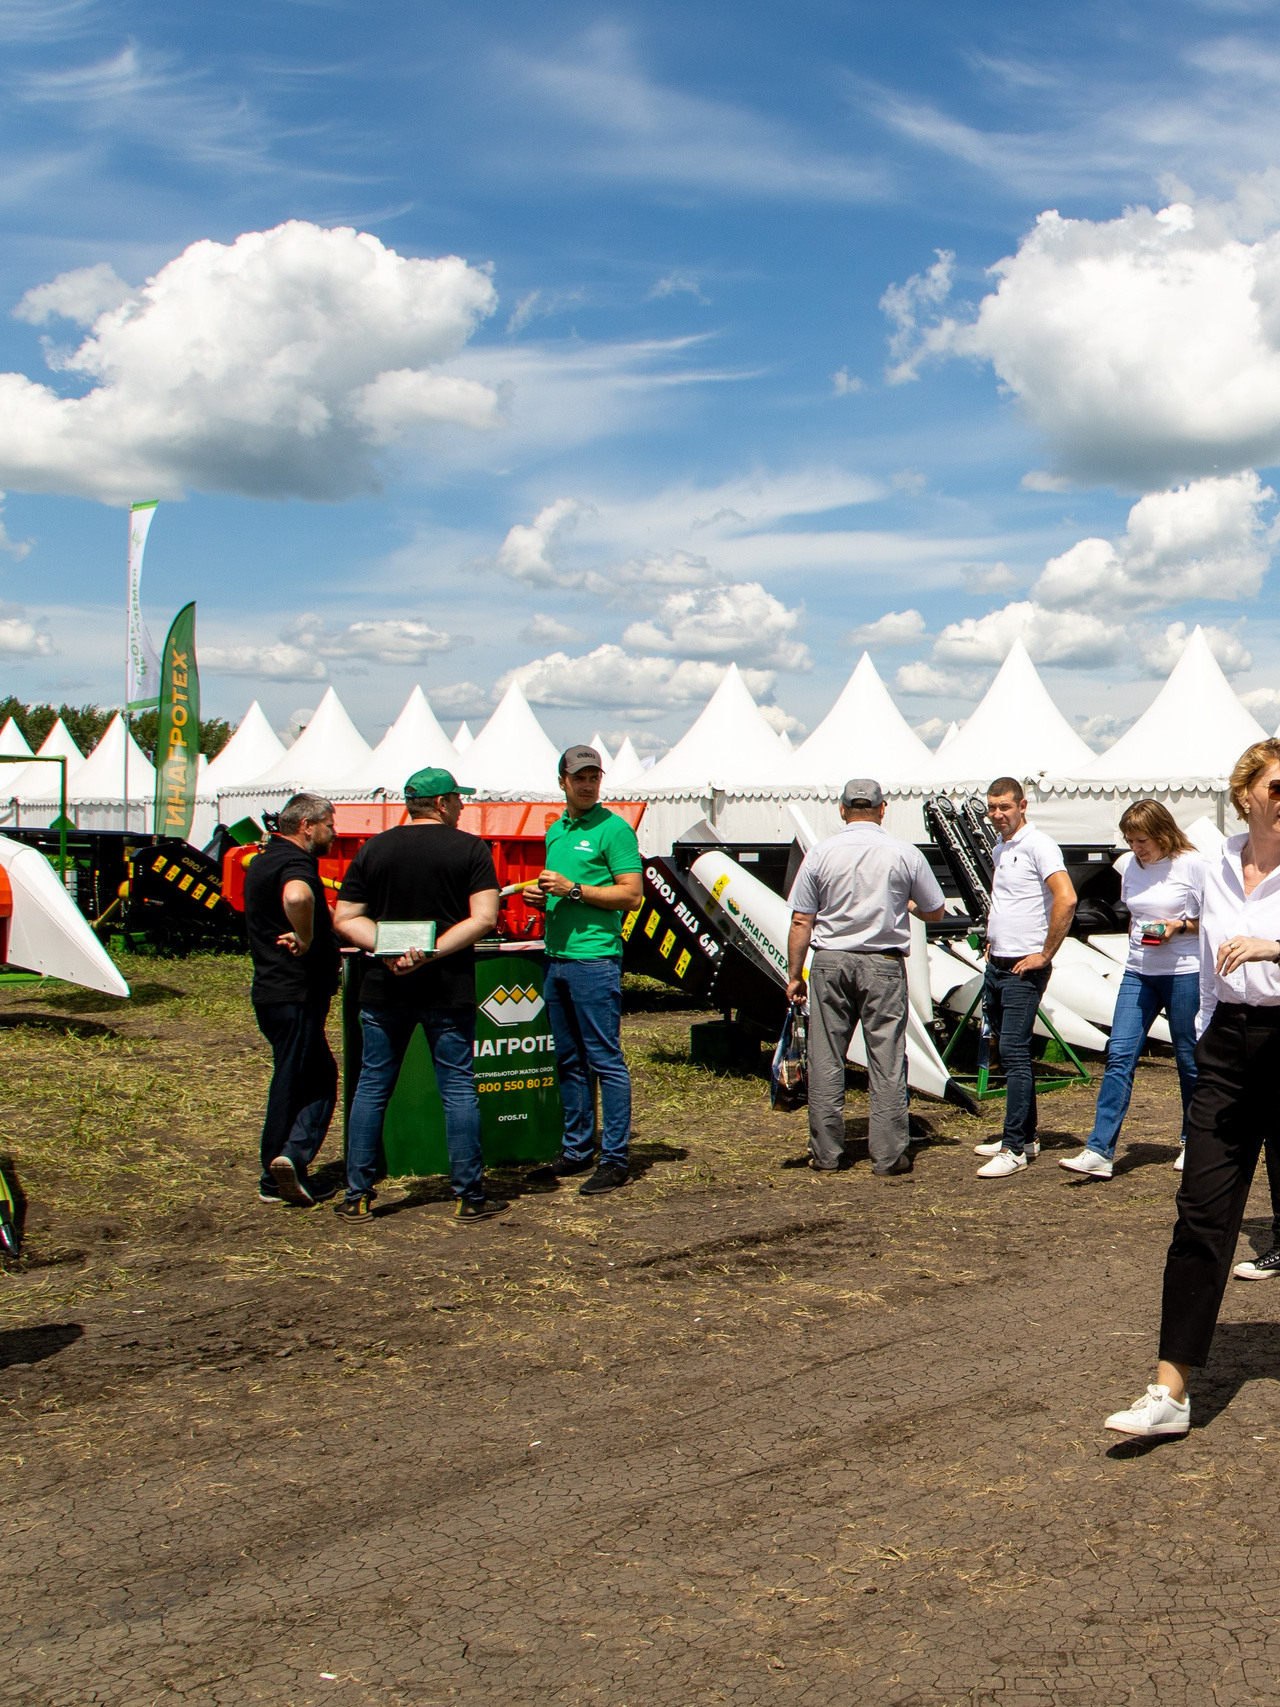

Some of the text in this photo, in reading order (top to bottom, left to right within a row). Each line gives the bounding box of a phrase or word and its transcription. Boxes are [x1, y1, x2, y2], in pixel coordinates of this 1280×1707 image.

[165, 649, 189, 827] ИНАГРОТЕХ
[181, 857, 205, 873] OROS
[645, 866, 720, 958] OROS RUS 6R
[741, 913, 789, 973] ИНАГРОТЕХ
[473, 1034, 555, 1058] АГРОТЕ
[474, 1065, 554, 1079] ИСТРИБЬЮТОР ЖАТОК OROS
[478, 1076, 554, 1093] 800 550 80 22
[498, 1113, 528, 1121] oros.ru
